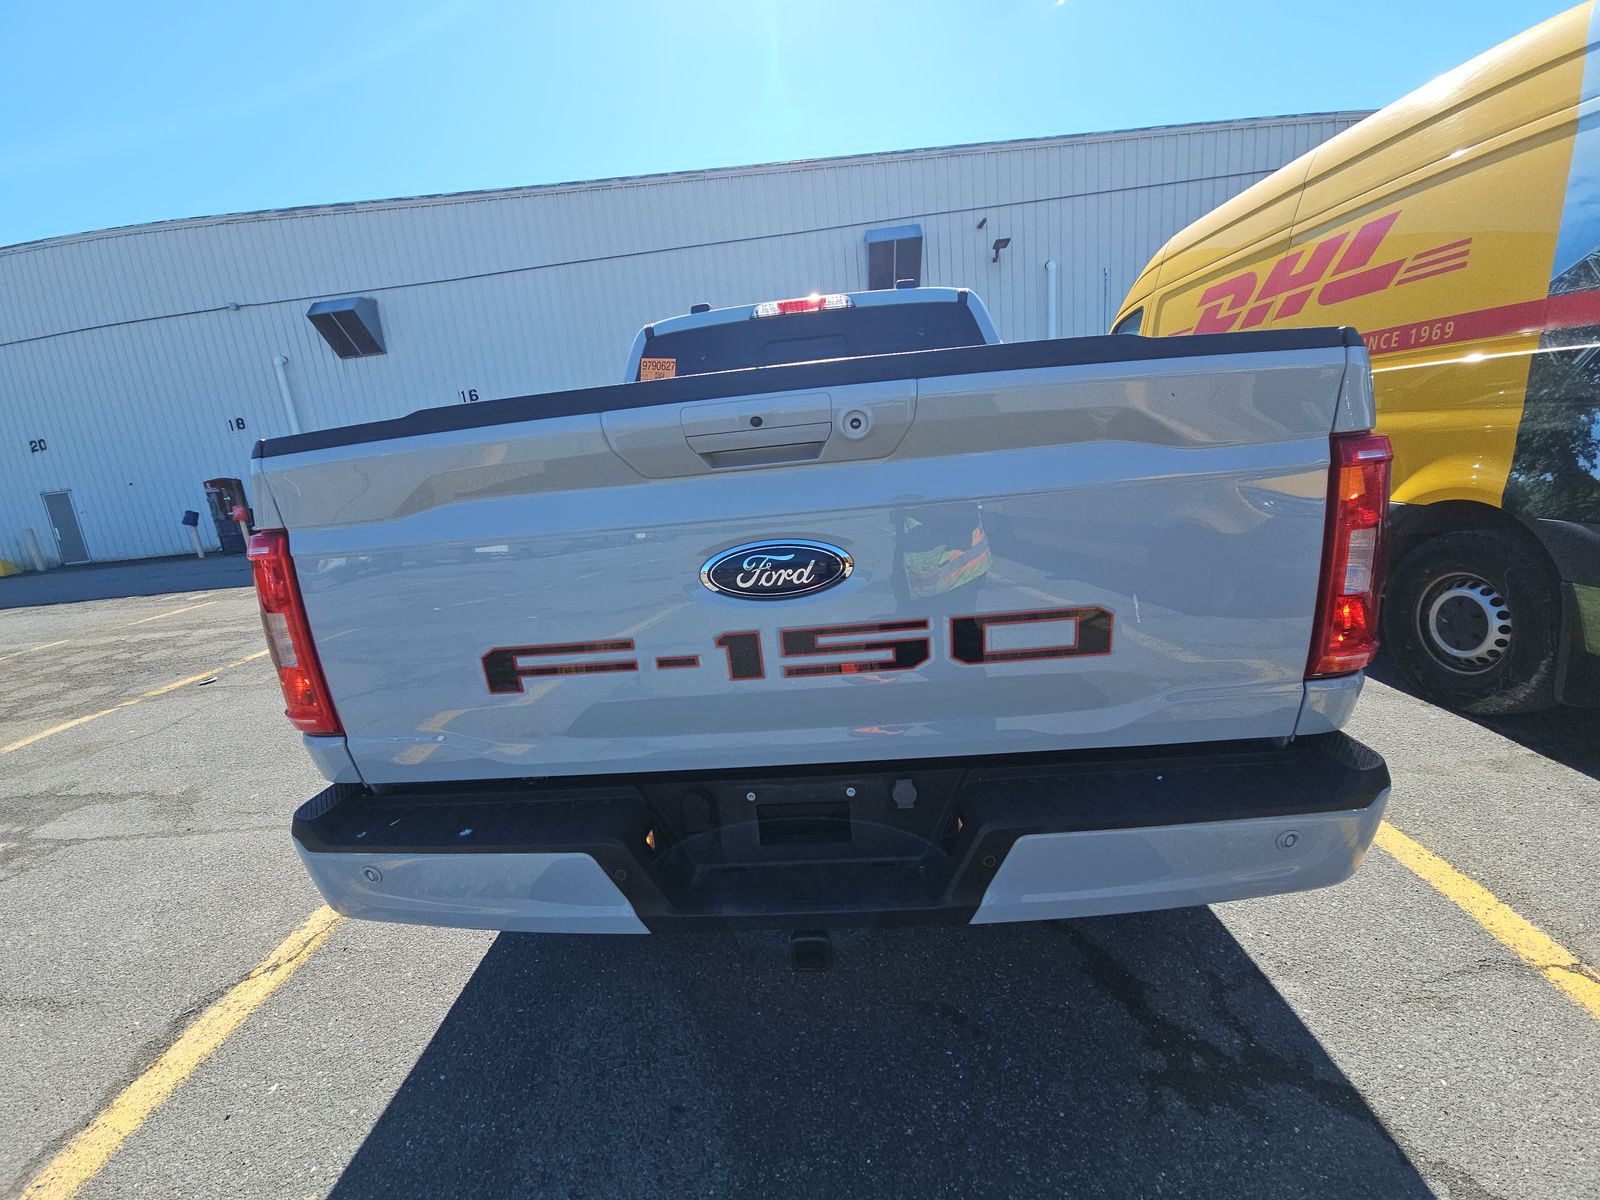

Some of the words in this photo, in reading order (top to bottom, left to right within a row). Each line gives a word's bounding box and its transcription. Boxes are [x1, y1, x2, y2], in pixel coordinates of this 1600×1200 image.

[1193, 210, 1408, 334] DHL
[1363, 331, 1401, 351] NCE
[1409, 321, 1455, 344] 1969
[642, 361, 676, 371] 9790627
[461, 389, 480, 403] 16
[228, 417, 246, 431] 18
[29, 438, 48, 454] 20
[736, 553, 816, 589] Ford
[481, 605, 1114, 695] F-150
